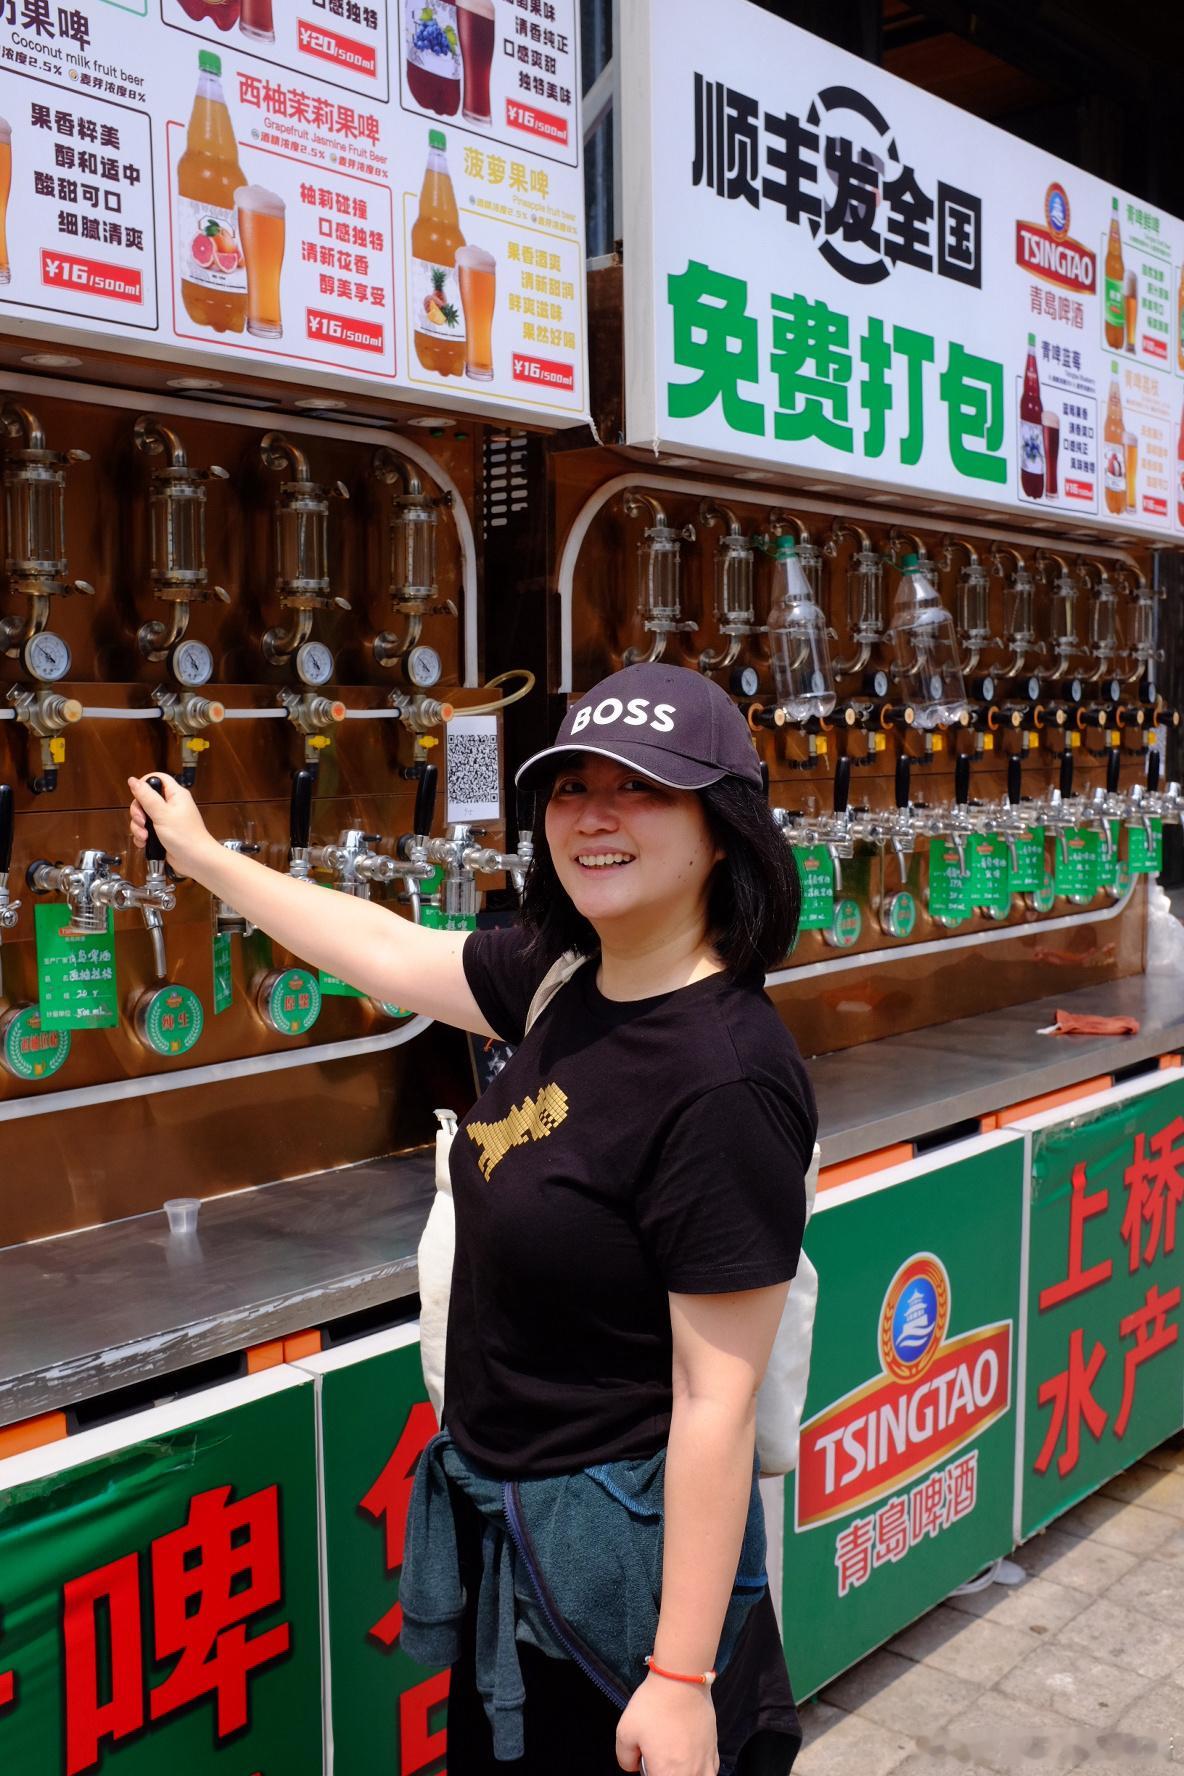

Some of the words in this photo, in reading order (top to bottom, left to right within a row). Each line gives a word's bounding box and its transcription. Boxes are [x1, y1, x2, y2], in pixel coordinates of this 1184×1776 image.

[501, 0, 556, 22] 萄果味
[504, 38, 556, 75] 口感爽甜
[515, 16, 568, 55] 清香纯正
[11, 32, 62, 60] Coconut
[66, 53, 91, 70] milk
[93, 60, 117, 78] fruit
[120, 69, 144, 86] beer
[31, 102, 120, 150] 果香粹美
[236, 72, 380, 147] 西柚茉莉果啤
[264, 117, 309, 141] Grapefruit
[311, 132, 347, 152] Jasmine
[348, 144, 367, 158] Fruit
[369, 151, 388, 164] Beer
[54, 143, 141, 186] 醇和适中
[464, 146, 549, 200] 菠萝果啤
[692, 72, 982, 290] 顺丰发全国
[34, 170, 122, 214] 酸甜可口
[300, 183, 368, 220] 柚莉碰撞
[58, 210, 144, 252] 细腻清爽
[318, 216, 384, 252] 口感独特
[45, 258, 141, 297] ¥16/500ml
[301, 240, 369, 277] 清新花香
[1020, 230, 1092, 285] TSINGTAO
[319, 274, 385, 308] 醇美享受
[308, 315, 383, 348] ¥16/500ml
[514, 359, 573, 386] ¥16/500ml
[667, 260, 1008, 484] 免费打包
[570, 697, 677, 736] BOSS
[1039, 1116, 1184, 1311] 上桥
[1034, 1283, 1182, 1478] 水产
[814, 1349, 998, 1496] TSINGTAO
